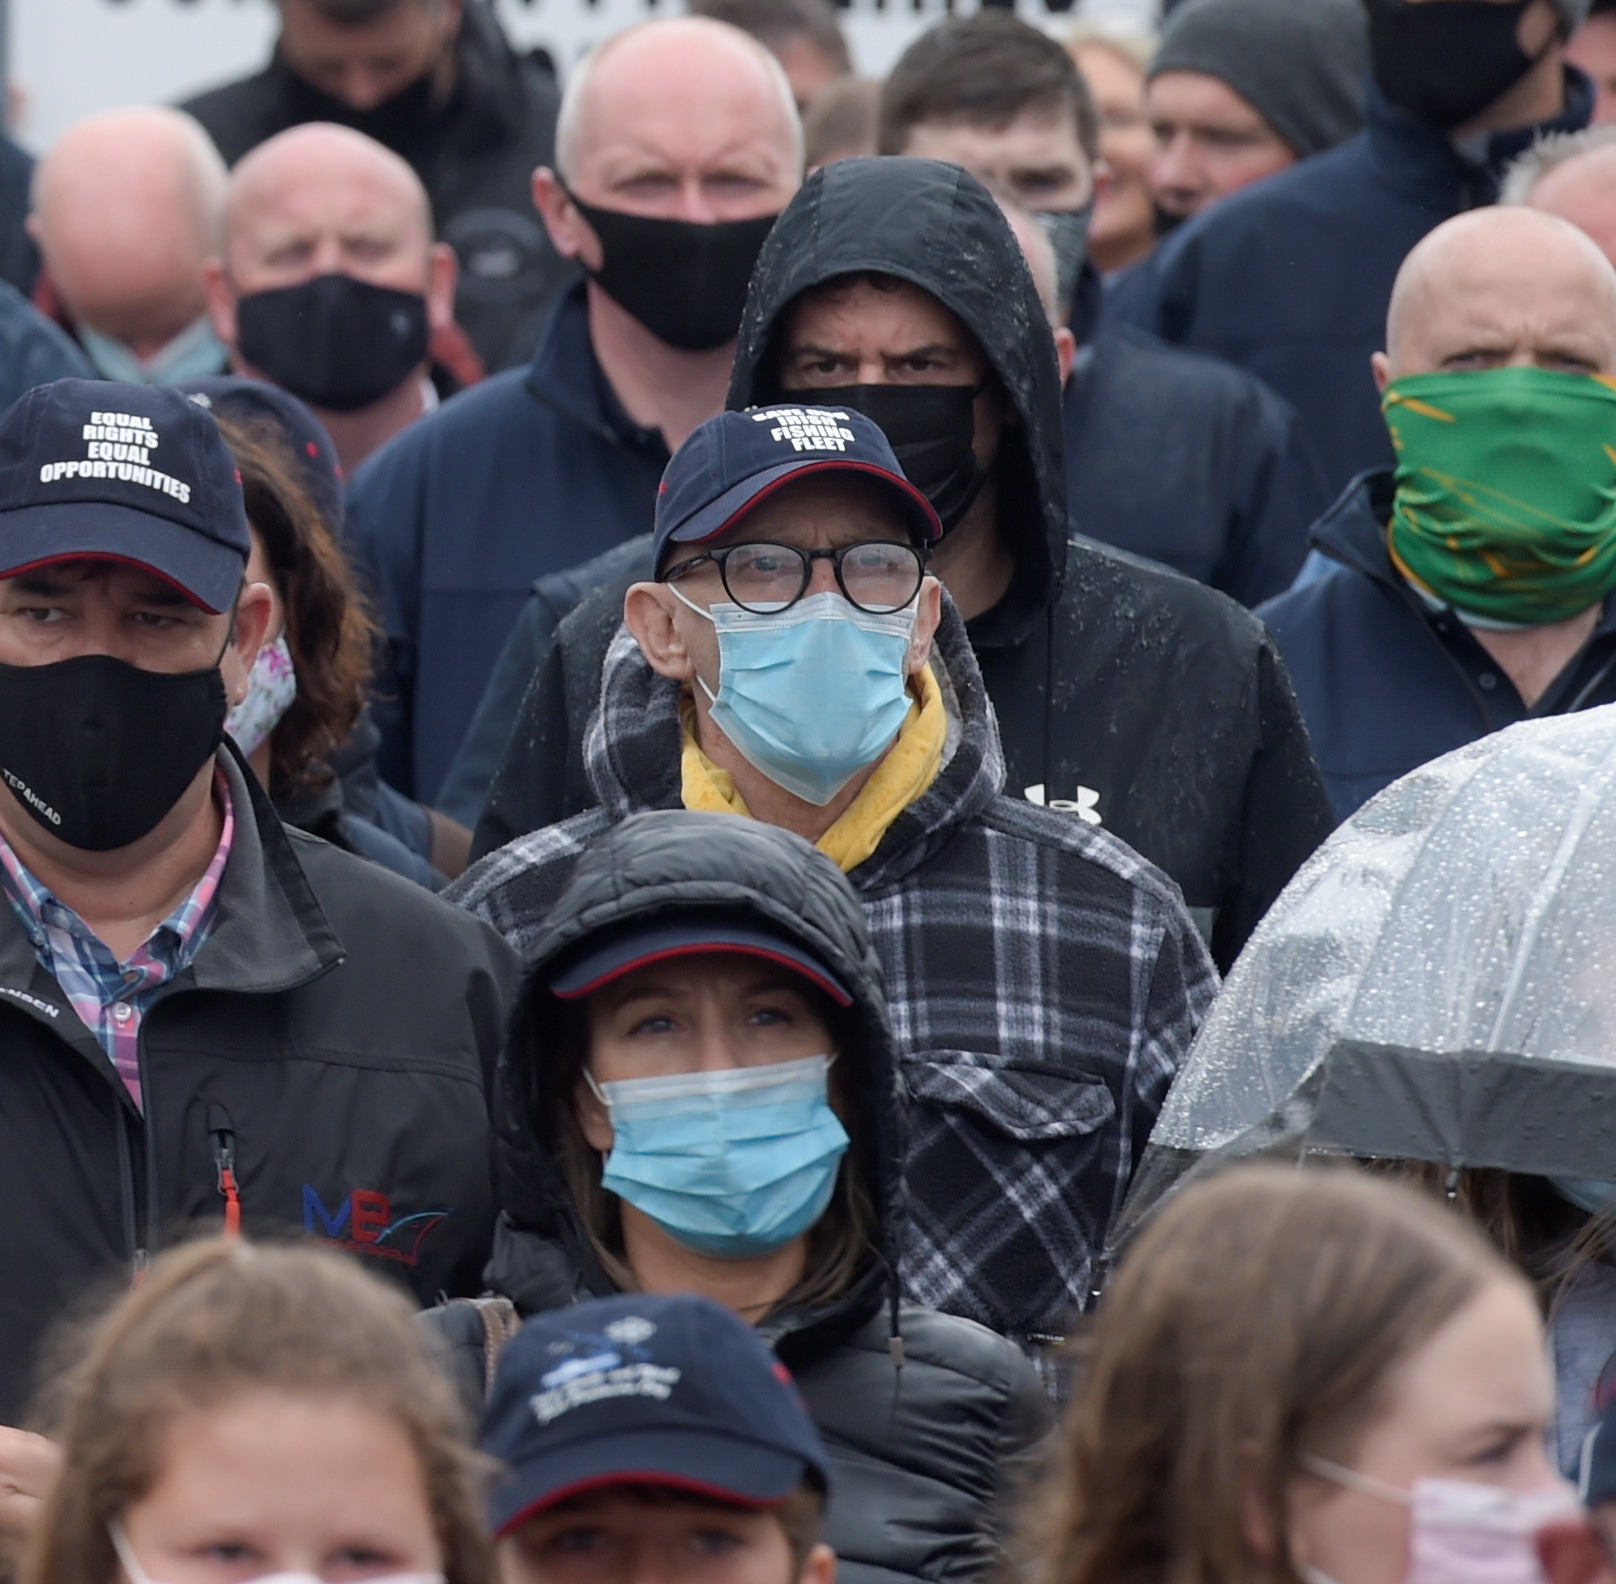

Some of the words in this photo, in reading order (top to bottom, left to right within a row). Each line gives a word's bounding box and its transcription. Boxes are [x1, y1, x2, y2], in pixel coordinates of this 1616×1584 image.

[90, 411, 153, 430] EQUAL
[82, 424, 159, 449] RIGHTS
[770, 425, 856, 442] FISHING
[791, 436, 846, 452] FLEET
[87, 442, 151, 466] EQUAL
[39, 461, 191, 504] OPPORTUNITIES
